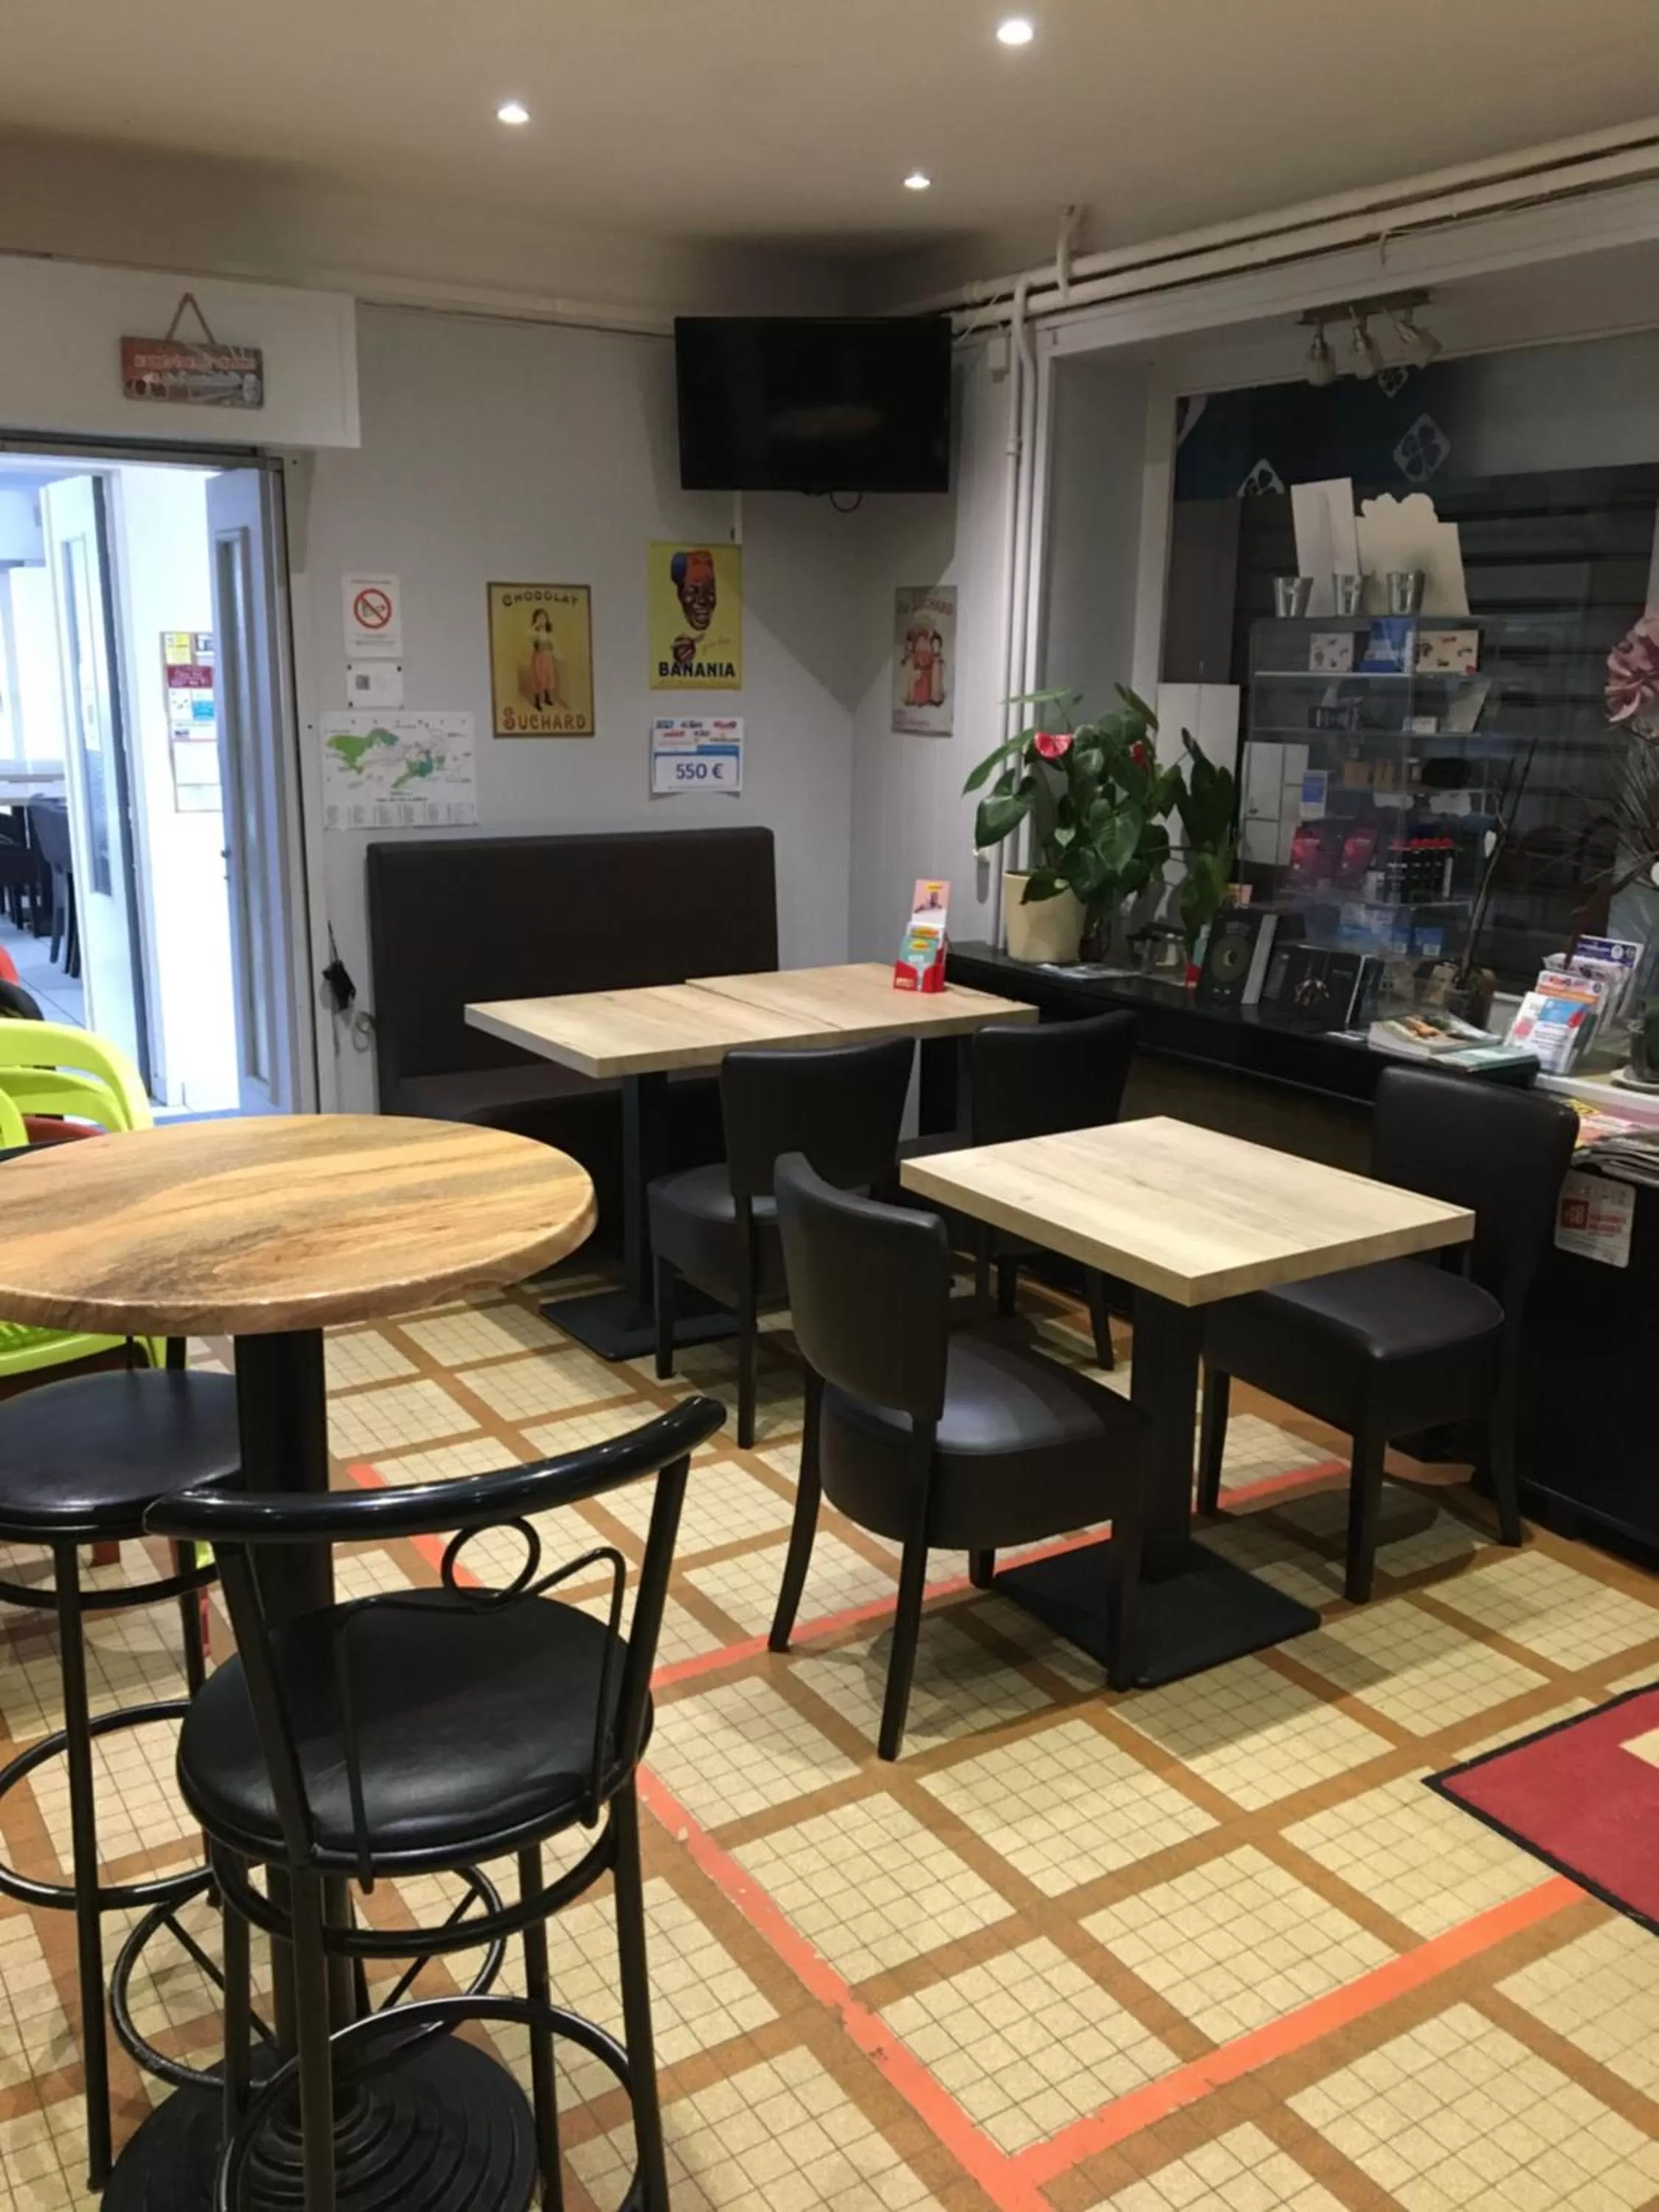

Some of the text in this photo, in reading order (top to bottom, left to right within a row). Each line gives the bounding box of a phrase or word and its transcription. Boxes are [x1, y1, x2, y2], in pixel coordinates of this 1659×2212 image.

[502, 591, 578, 607] CHOCOLAT
[658, 661, 735, 677] BANANIA
[503, 706, 585, 730] SUCHARD
[676, 762, 724, 779] 550 €
